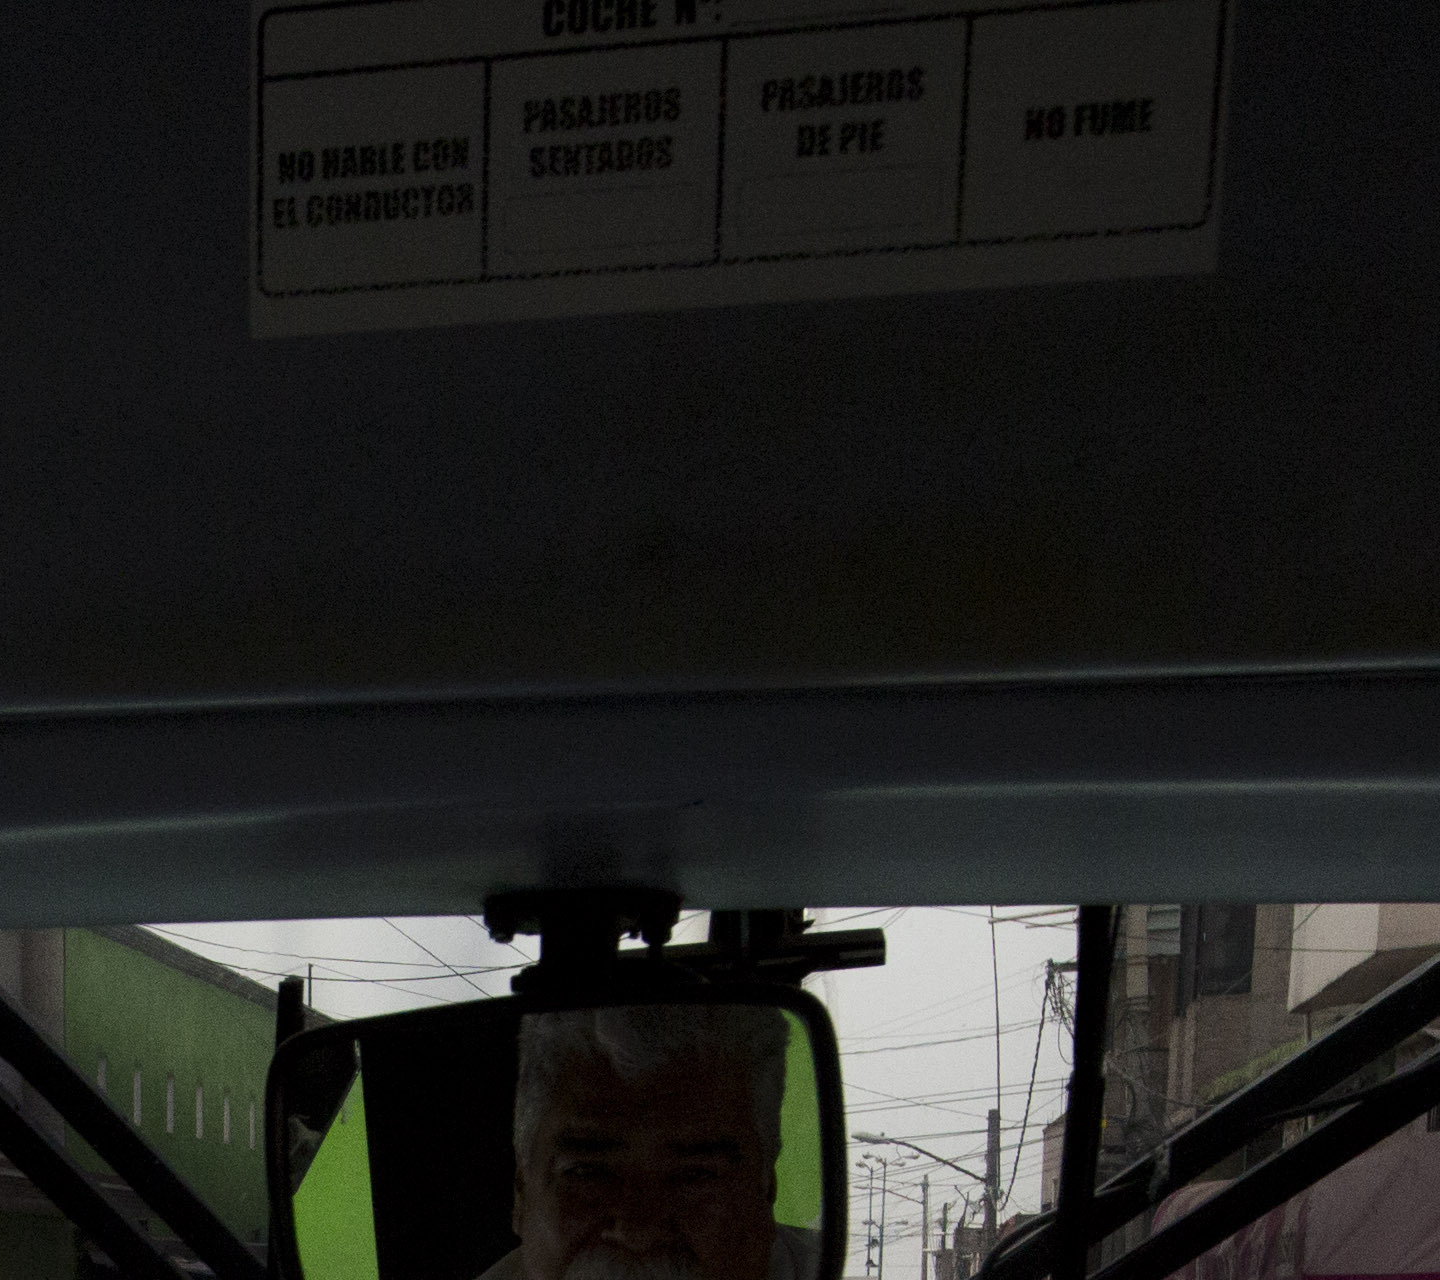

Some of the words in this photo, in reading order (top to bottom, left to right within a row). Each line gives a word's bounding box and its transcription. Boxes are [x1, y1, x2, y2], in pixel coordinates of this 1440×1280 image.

[543, 0, 657, 36] COCHE
[523, 88, 681, 133] PASAJEROS
[761, 67, 925, 112] PASAJEROS
[797, 123, 830, 157] DE
[839, 119, 885, 154] PIE
[1025, 108, 1066, 140] NO
[1074, 99, 1154, 136] FUME
[279, 148, 314, 183] NO
[322, 143, 406, 179] HABLE
[413, 137, 470, 172] CON
[530, 136, 674, 177] SENTADOS
[272, 195, 300, 228] EL
[307, 184, 475, 227] CONDUCTOR
